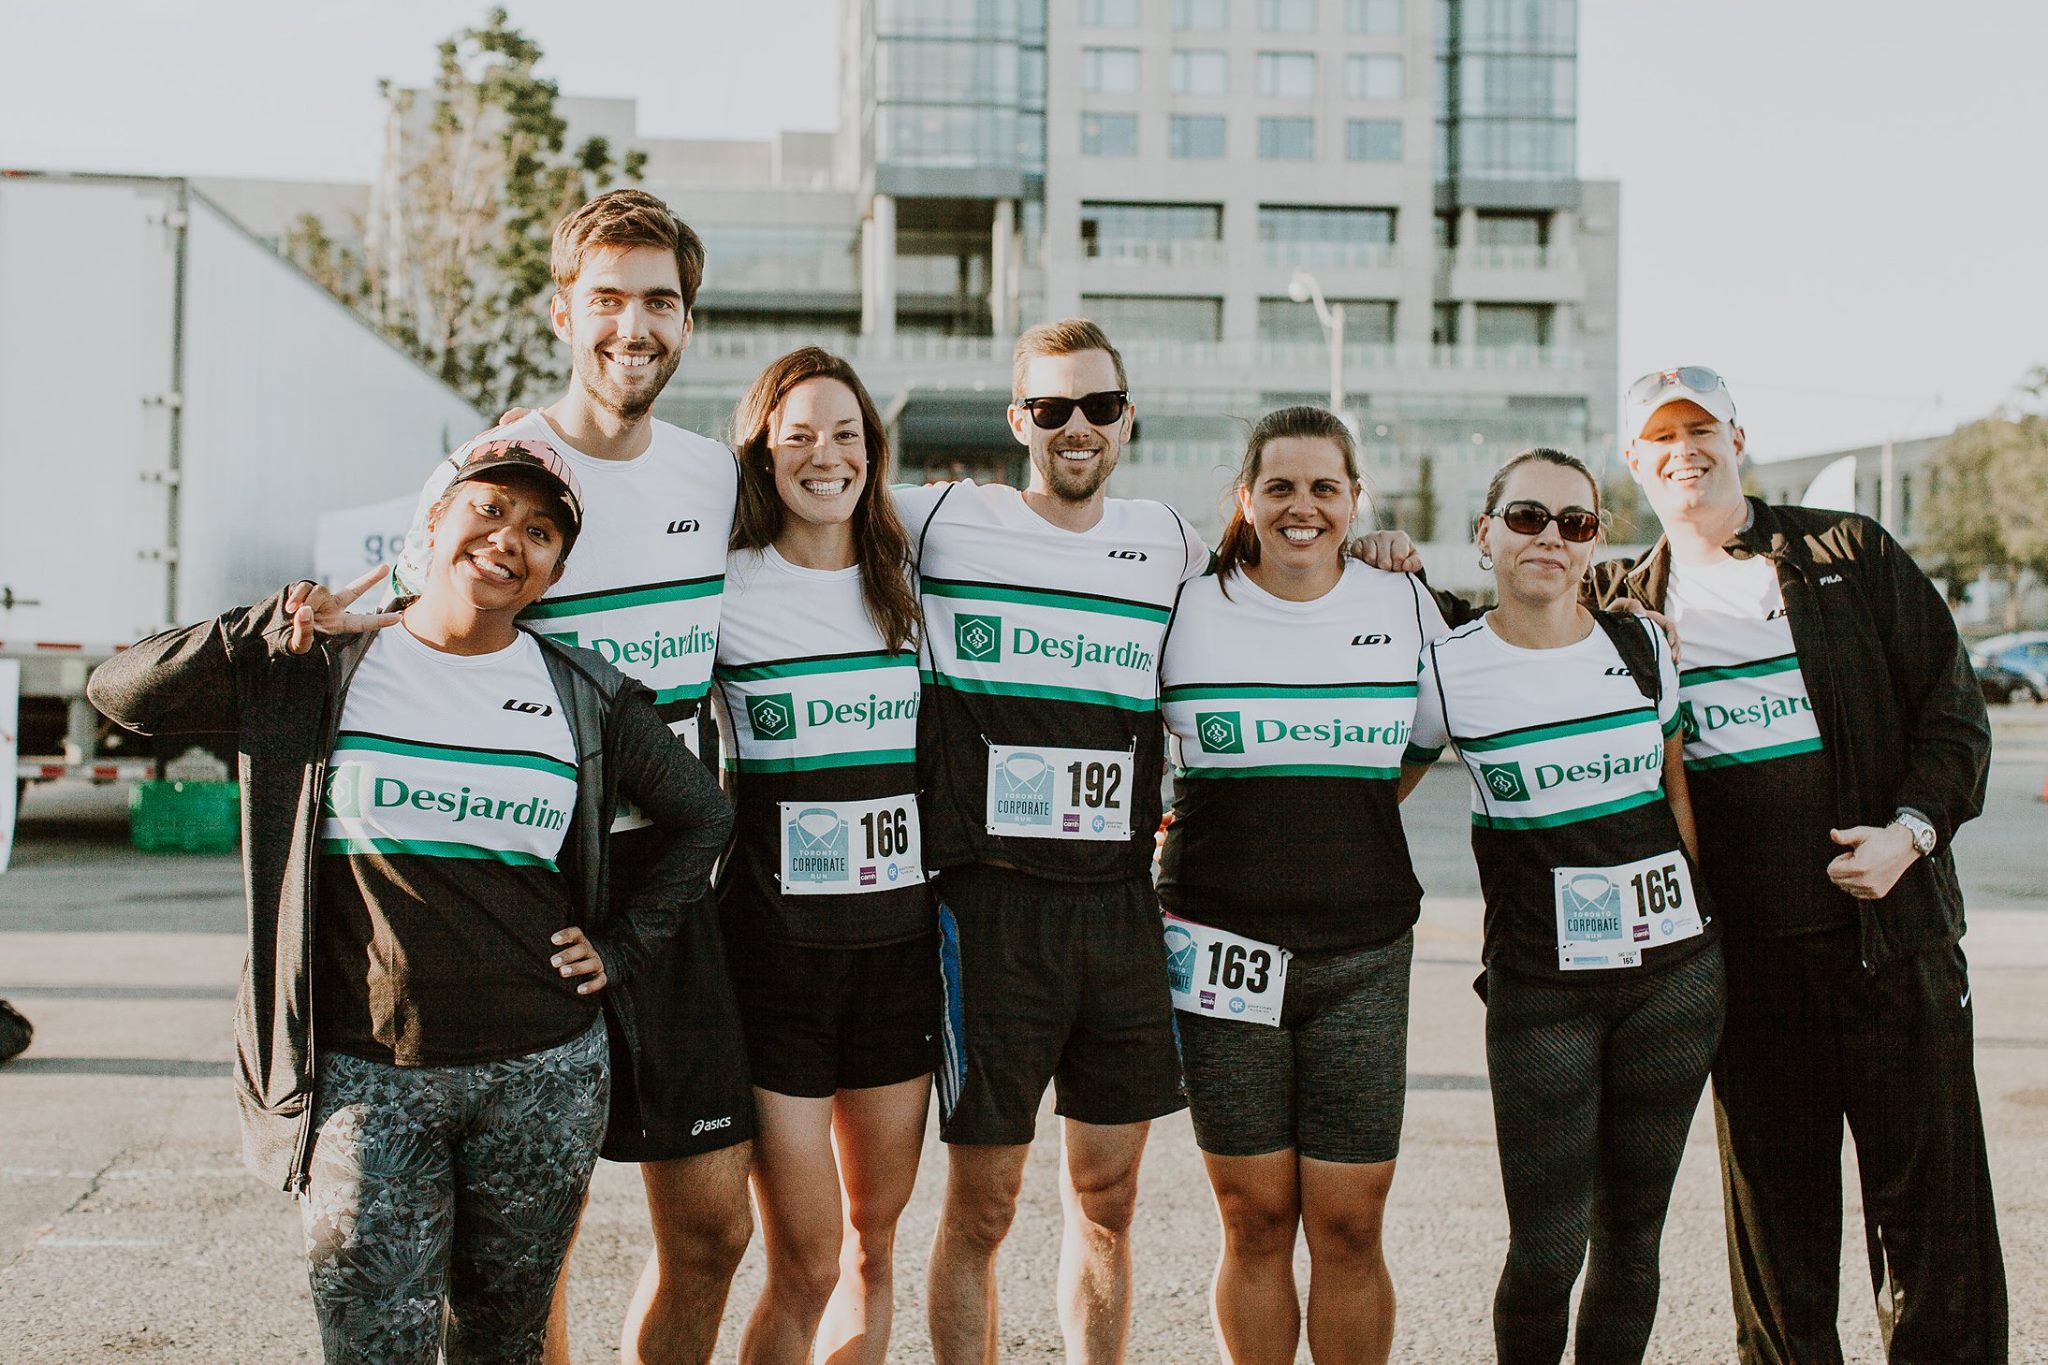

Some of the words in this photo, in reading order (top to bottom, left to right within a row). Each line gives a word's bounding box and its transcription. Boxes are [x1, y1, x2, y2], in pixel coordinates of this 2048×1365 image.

[1819, 574, 1842, 586] FILA
[1068, 761, 1121, 808] 192
[374, 777, 566, 831] Desjardins
[998, 800, 1049, 816] CORPORATE
[860, 808, 908, 859] 166
[793, 857, 845, 871] CORPORATE
[1631, 864, 1682, 918] 165
[1573, 910, 1612, 918] TORONTO
[1567, 918, 1619, 932] CORPORATE
[1208, 942, 1271, 993] 163
[1623, 957, 1634, 965] 165
[704, 1117, 731, 1131] asics
